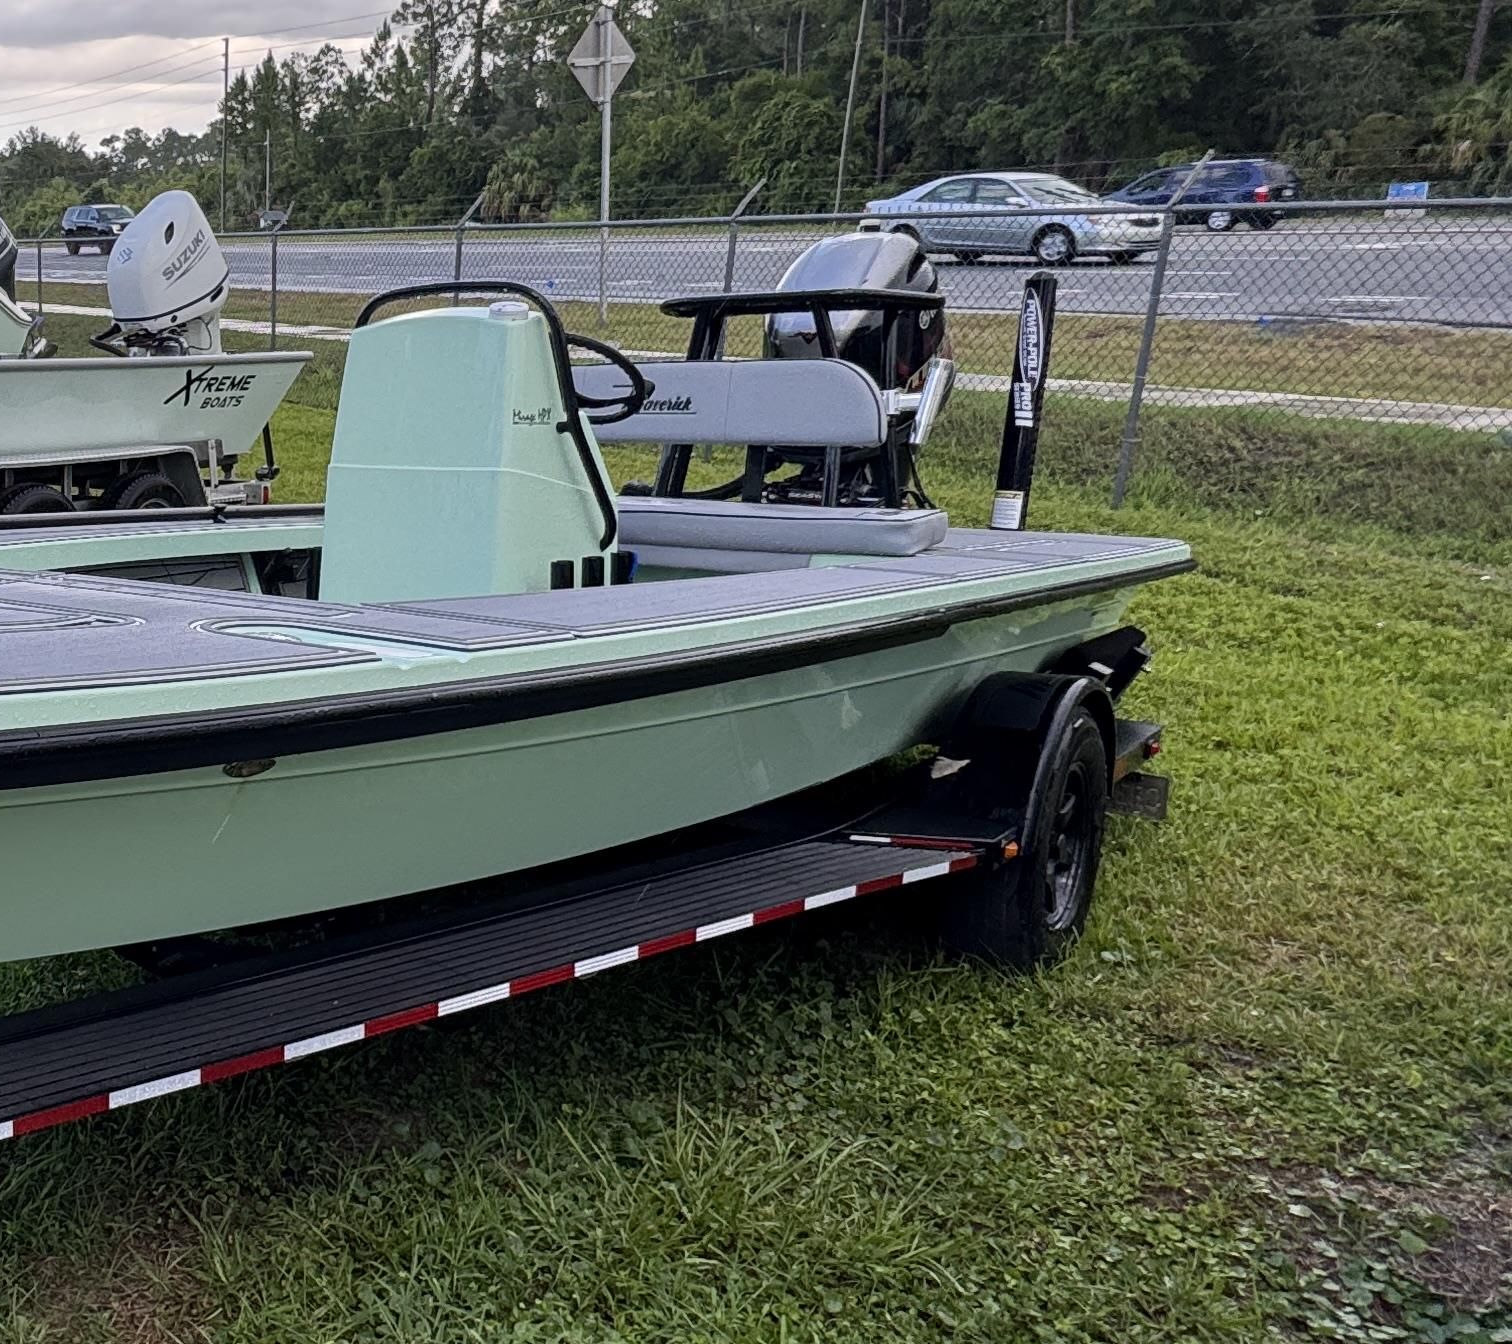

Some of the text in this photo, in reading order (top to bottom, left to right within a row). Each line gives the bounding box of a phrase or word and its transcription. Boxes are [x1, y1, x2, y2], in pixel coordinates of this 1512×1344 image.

[161, 228, 207, 282] SUZUKI
[1025, 299, 1039, 379] POWER-POLE
[163, 365, 257, 407] XTREME
[200, 395, 245, 409] BOATS
[643, 396, 692, 411] averick
[1020, 382, 1032, 411] PRO
